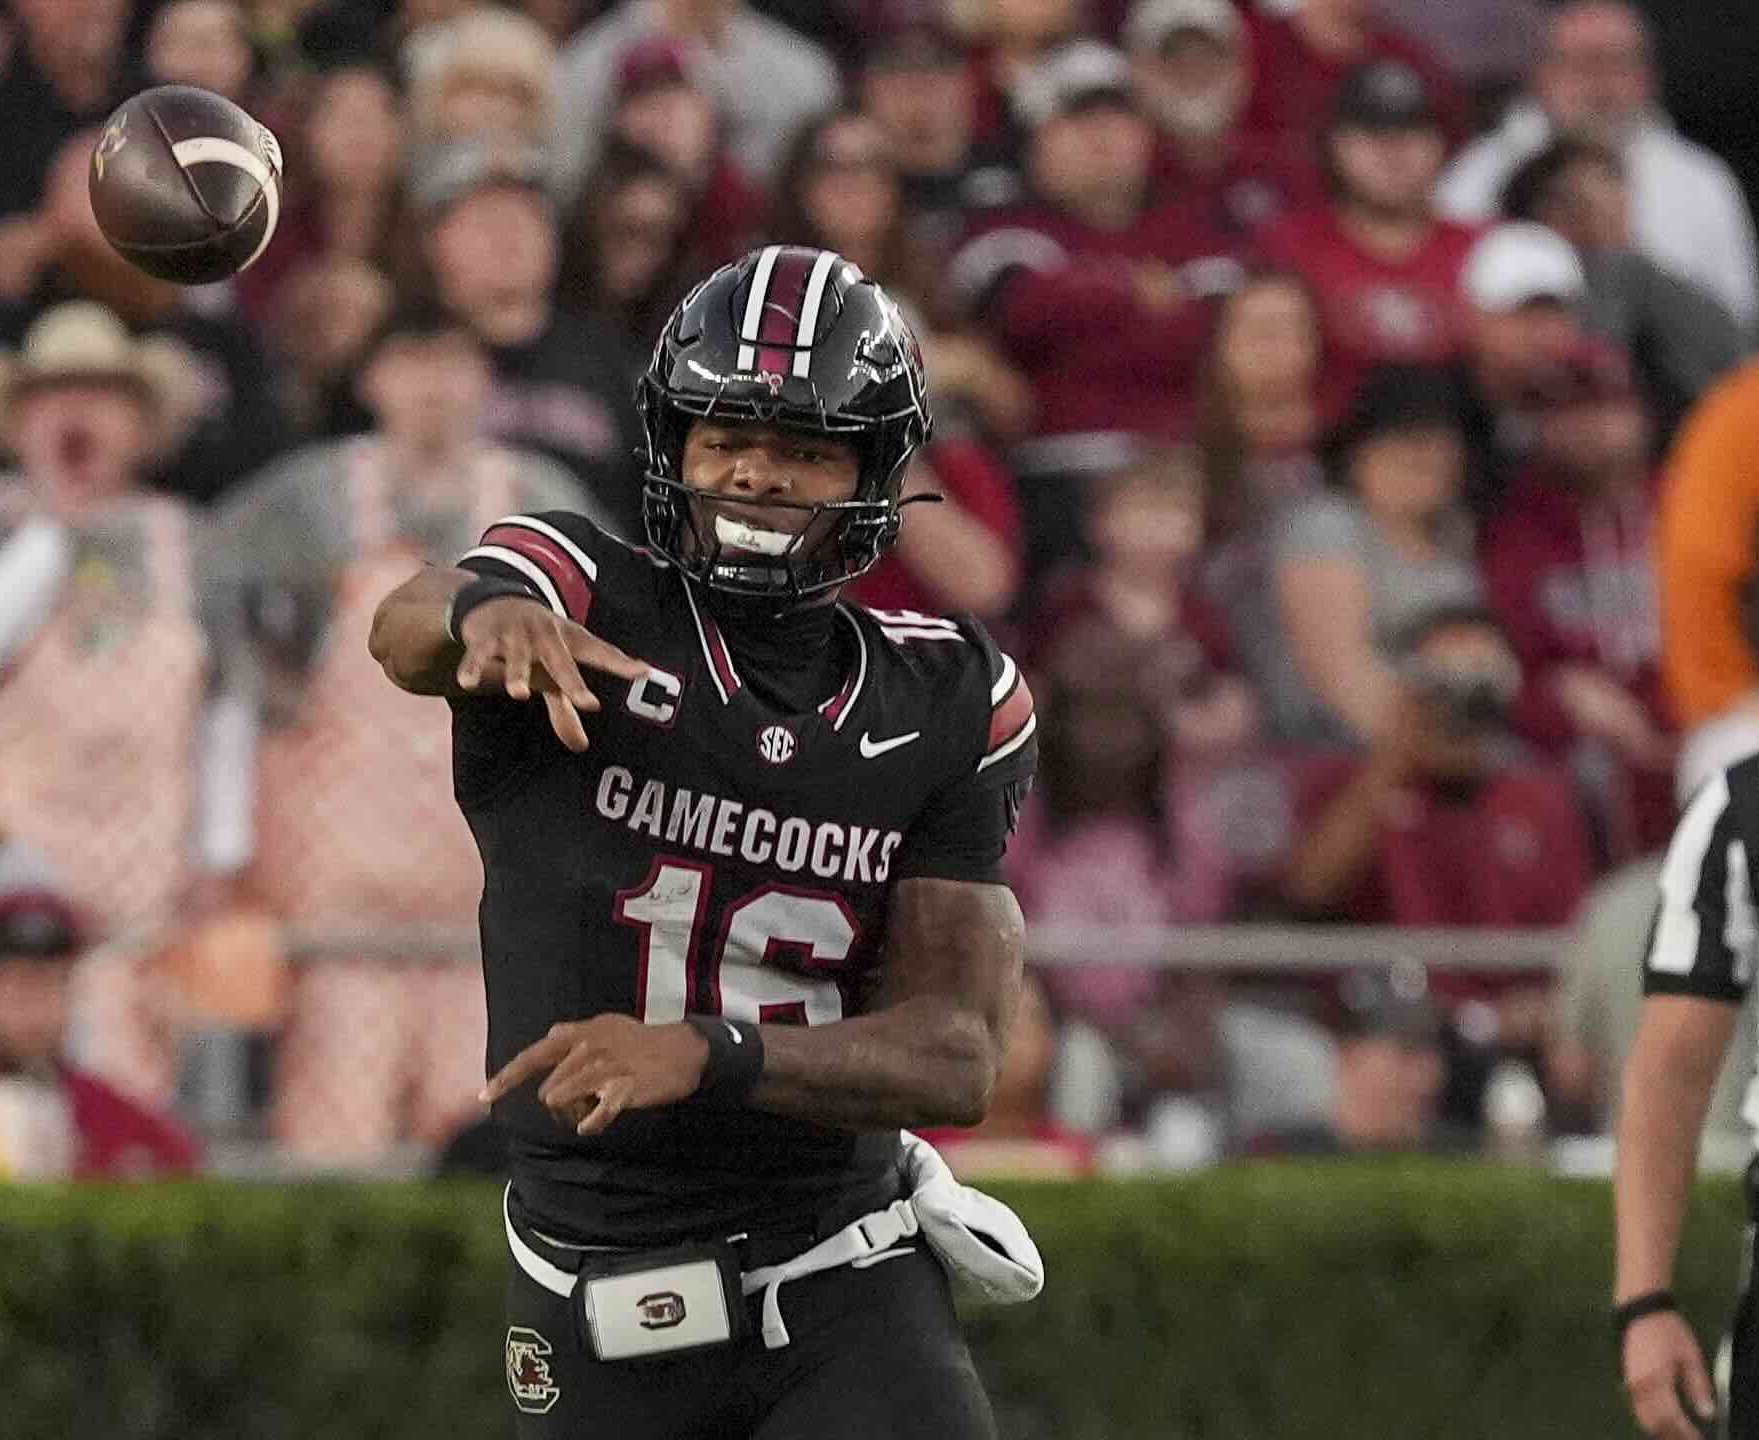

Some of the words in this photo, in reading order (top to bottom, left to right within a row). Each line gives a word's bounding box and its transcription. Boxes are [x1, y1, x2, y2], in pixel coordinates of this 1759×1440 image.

[626, 666, 682, 724] C
[758, 724, 797, 765] SEC
[595, 764, 903, 884] GAMECOCKS
[614, 858, 860, 1027] 16
